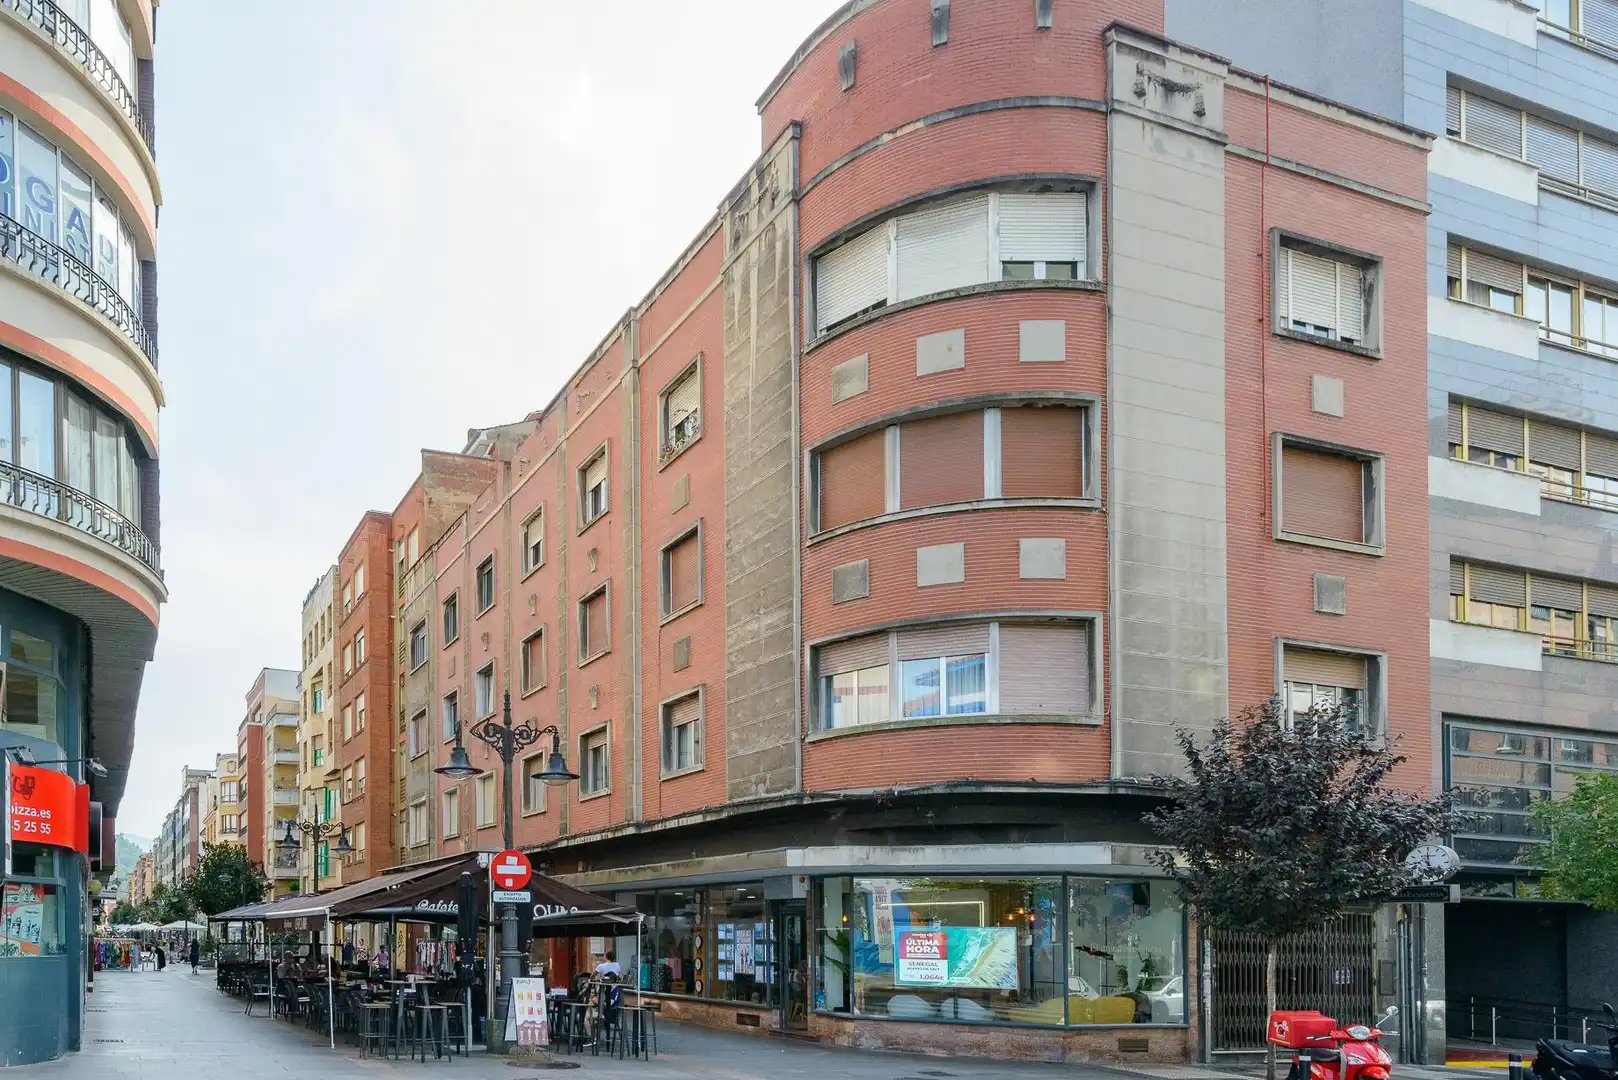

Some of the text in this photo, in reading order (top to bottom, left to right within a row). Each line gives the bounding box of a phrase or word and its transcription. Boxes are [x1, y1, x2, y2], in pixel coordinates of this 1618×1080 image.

[11, 819, 51, 834] 5 25 55
[417, 899, 459, 912] Cafete
[905, 938, 940, 946] ÚLTIMA
[906, 945, 940, 953] HORA
